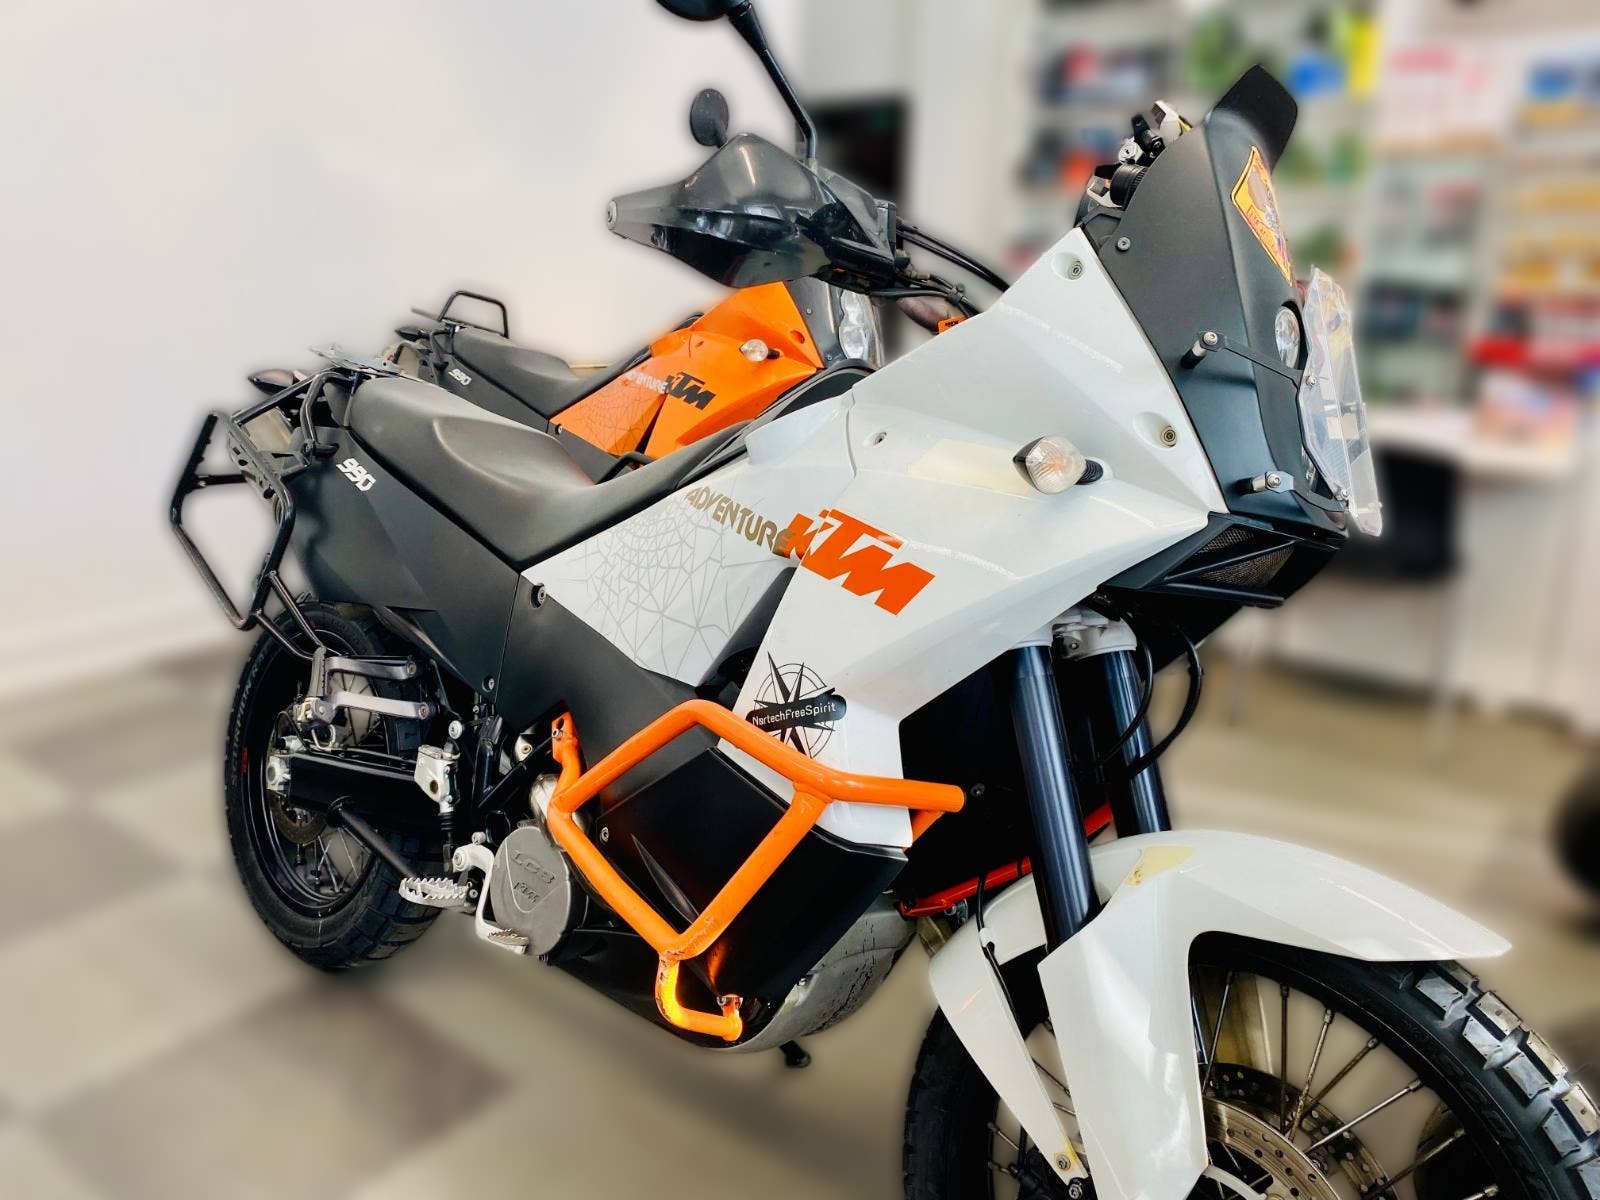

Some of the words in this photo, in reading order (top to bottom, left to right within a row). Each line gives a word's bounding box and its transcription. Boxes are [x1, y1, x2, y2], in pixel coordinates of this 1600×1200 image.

[447, 368, 472, 386] 990
[665, 371, 716, 410] KTM
[335, 457, 377, 491] 990
[685, 485, 794, 559] ADVENTURE
[783, 508, 935, 616] KTM
